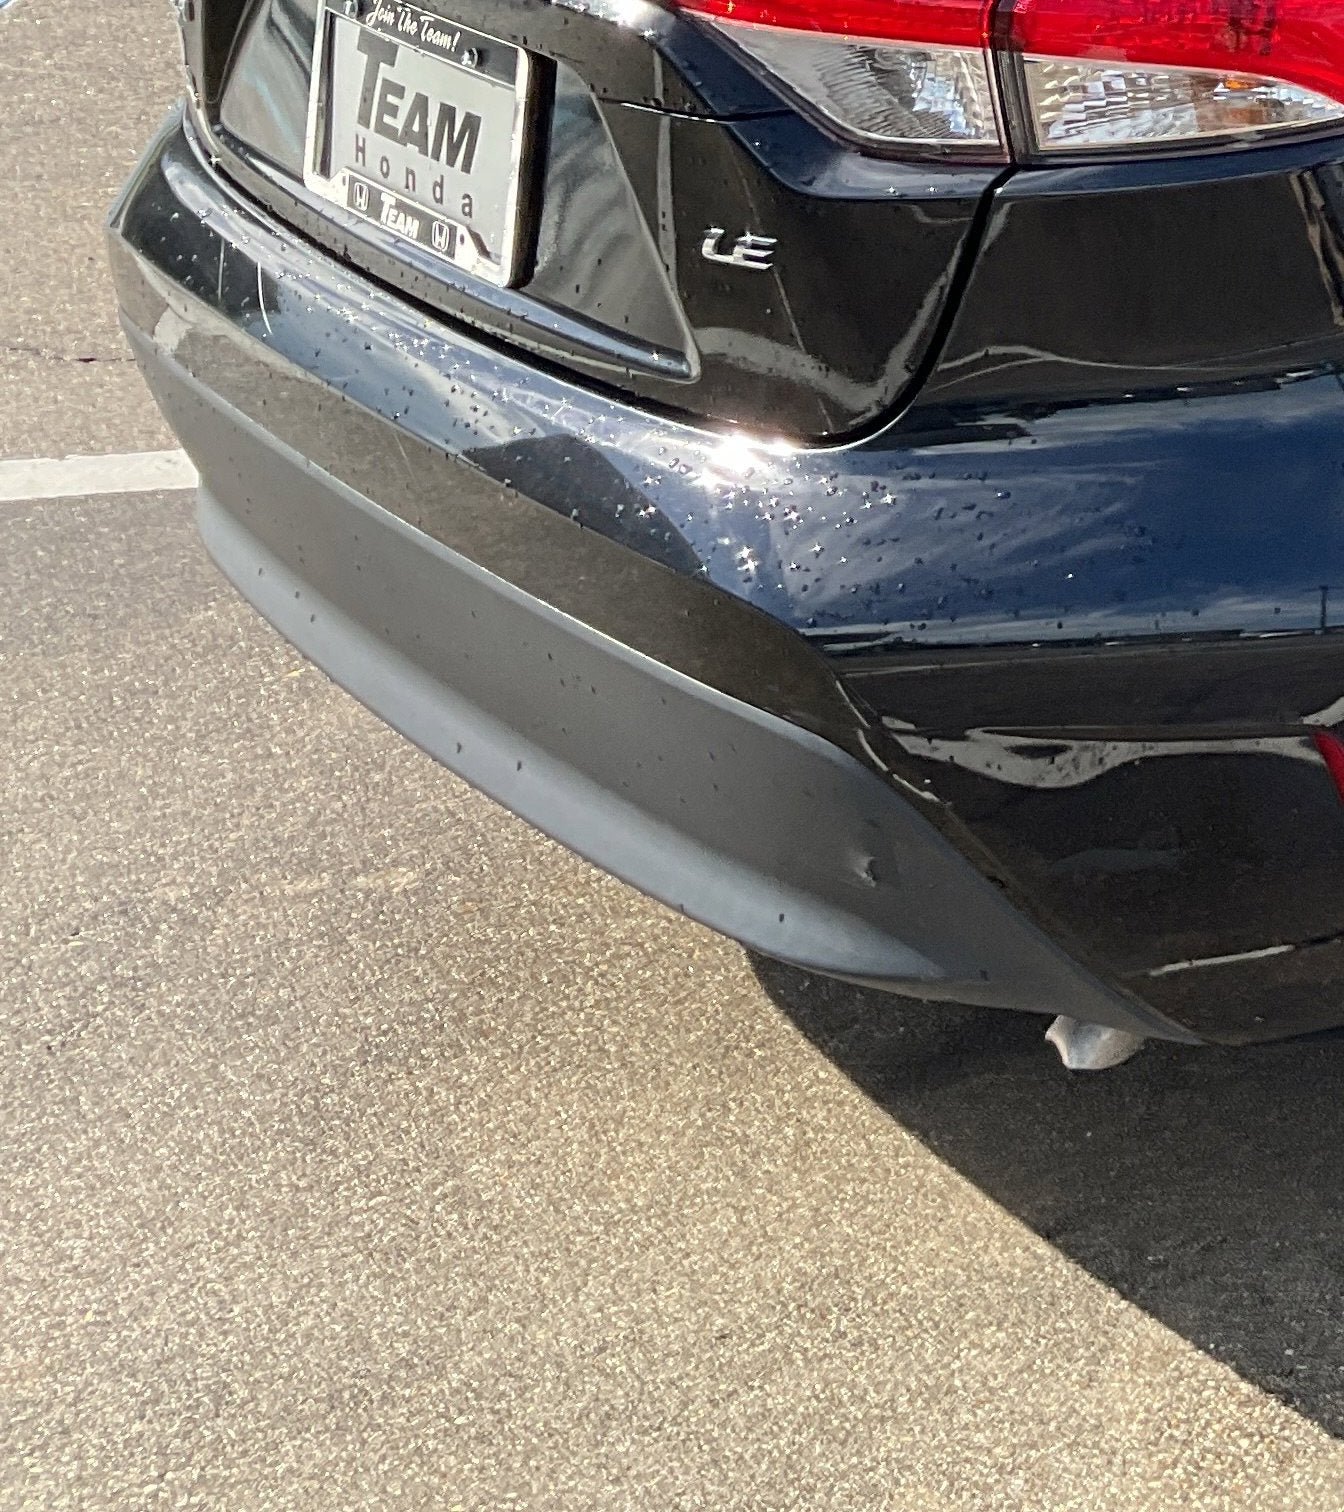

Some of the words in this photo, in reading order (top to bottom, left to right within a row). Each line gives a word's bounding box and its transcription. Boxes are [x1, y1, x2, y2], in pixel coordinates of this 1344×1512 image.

[396, 5, 418, 36] The
[420, 15, 461, 53] Team!
[356, 28, 482, 175] TEAM
[354, 133, 474, 219] Honda
[380, 193, 420, 240] TEAM
[702, 227, 778, 270] LE
